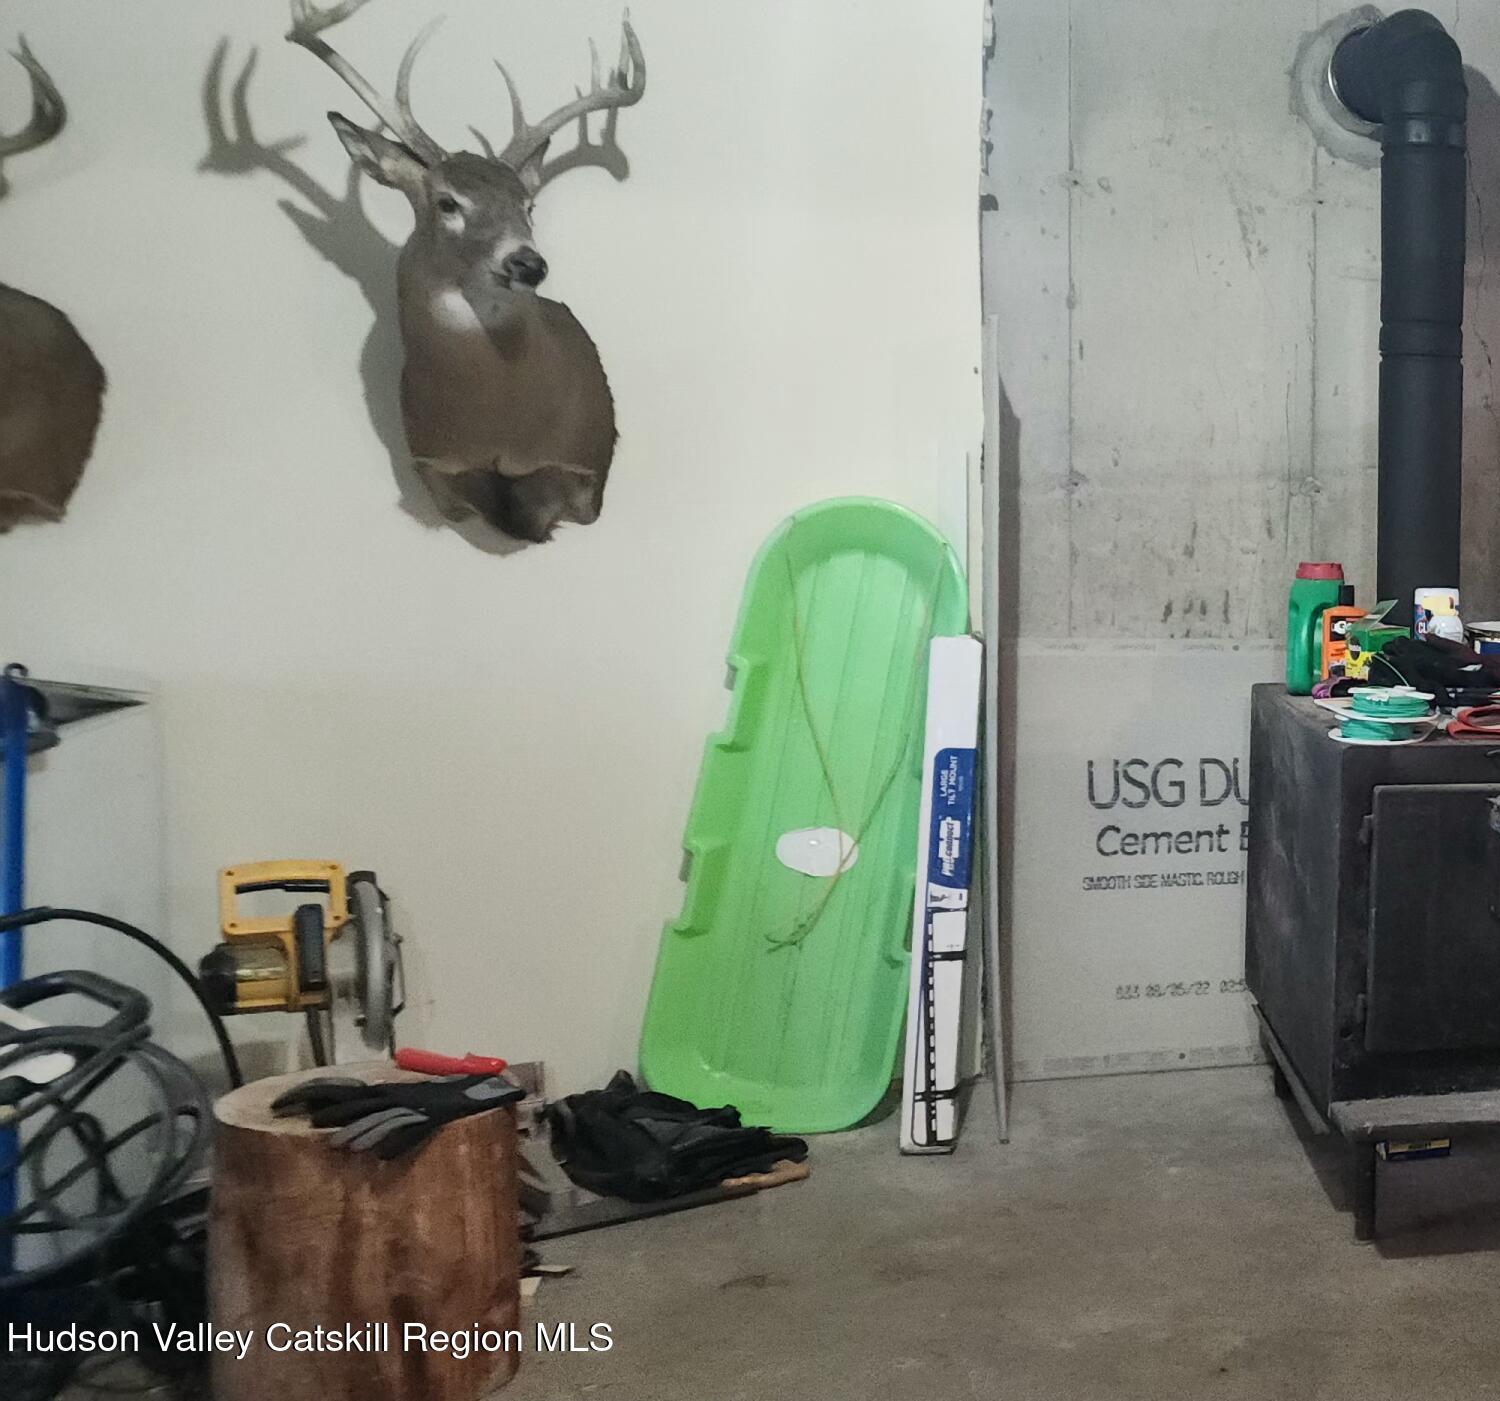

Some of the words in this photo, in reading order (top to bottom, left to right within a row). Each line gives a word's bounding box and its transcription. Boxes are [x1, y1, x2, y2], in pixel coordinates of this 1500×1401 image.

[949, 755, 958, 782] MOUNT
[940, 770, 949, 797] LARGE
[947, 786, 956, 805] TILT
[1087, 757, 1186, 809] USG
[1096, 823, 1230, 857] Cement
[1083, 874, 1132, 891] SMOOTH
[1134, 874, 1159, 889] SIDE
[1207, 870, 1245, 886] ROUGH
